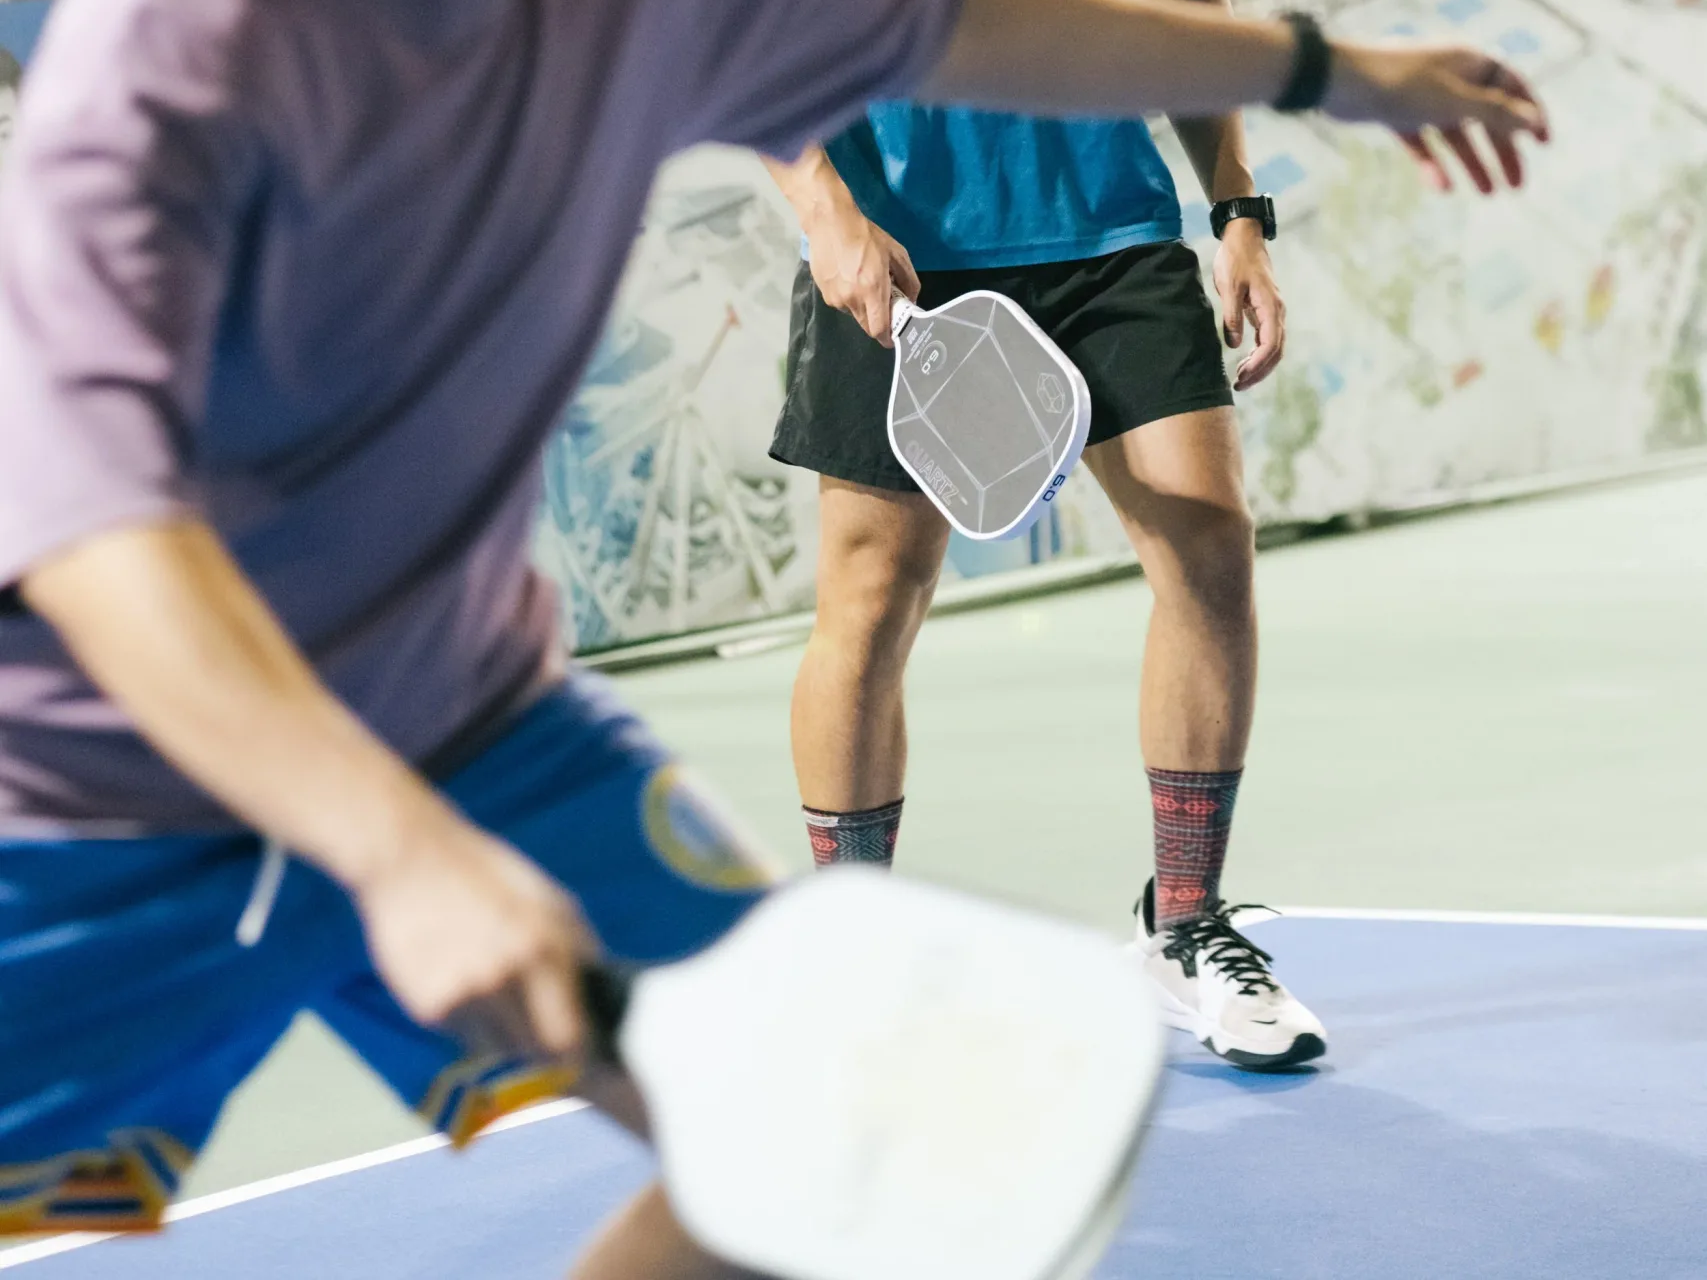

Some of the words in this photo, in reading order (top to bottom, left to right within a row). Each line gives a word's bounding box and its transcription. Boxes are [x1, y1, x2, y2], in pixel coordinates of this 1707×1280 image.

[921, 349, 939, 374] 6.0
[905, 440, 959, 506] QUARTZ
[1042, 474, 1066, 502] 6.0
